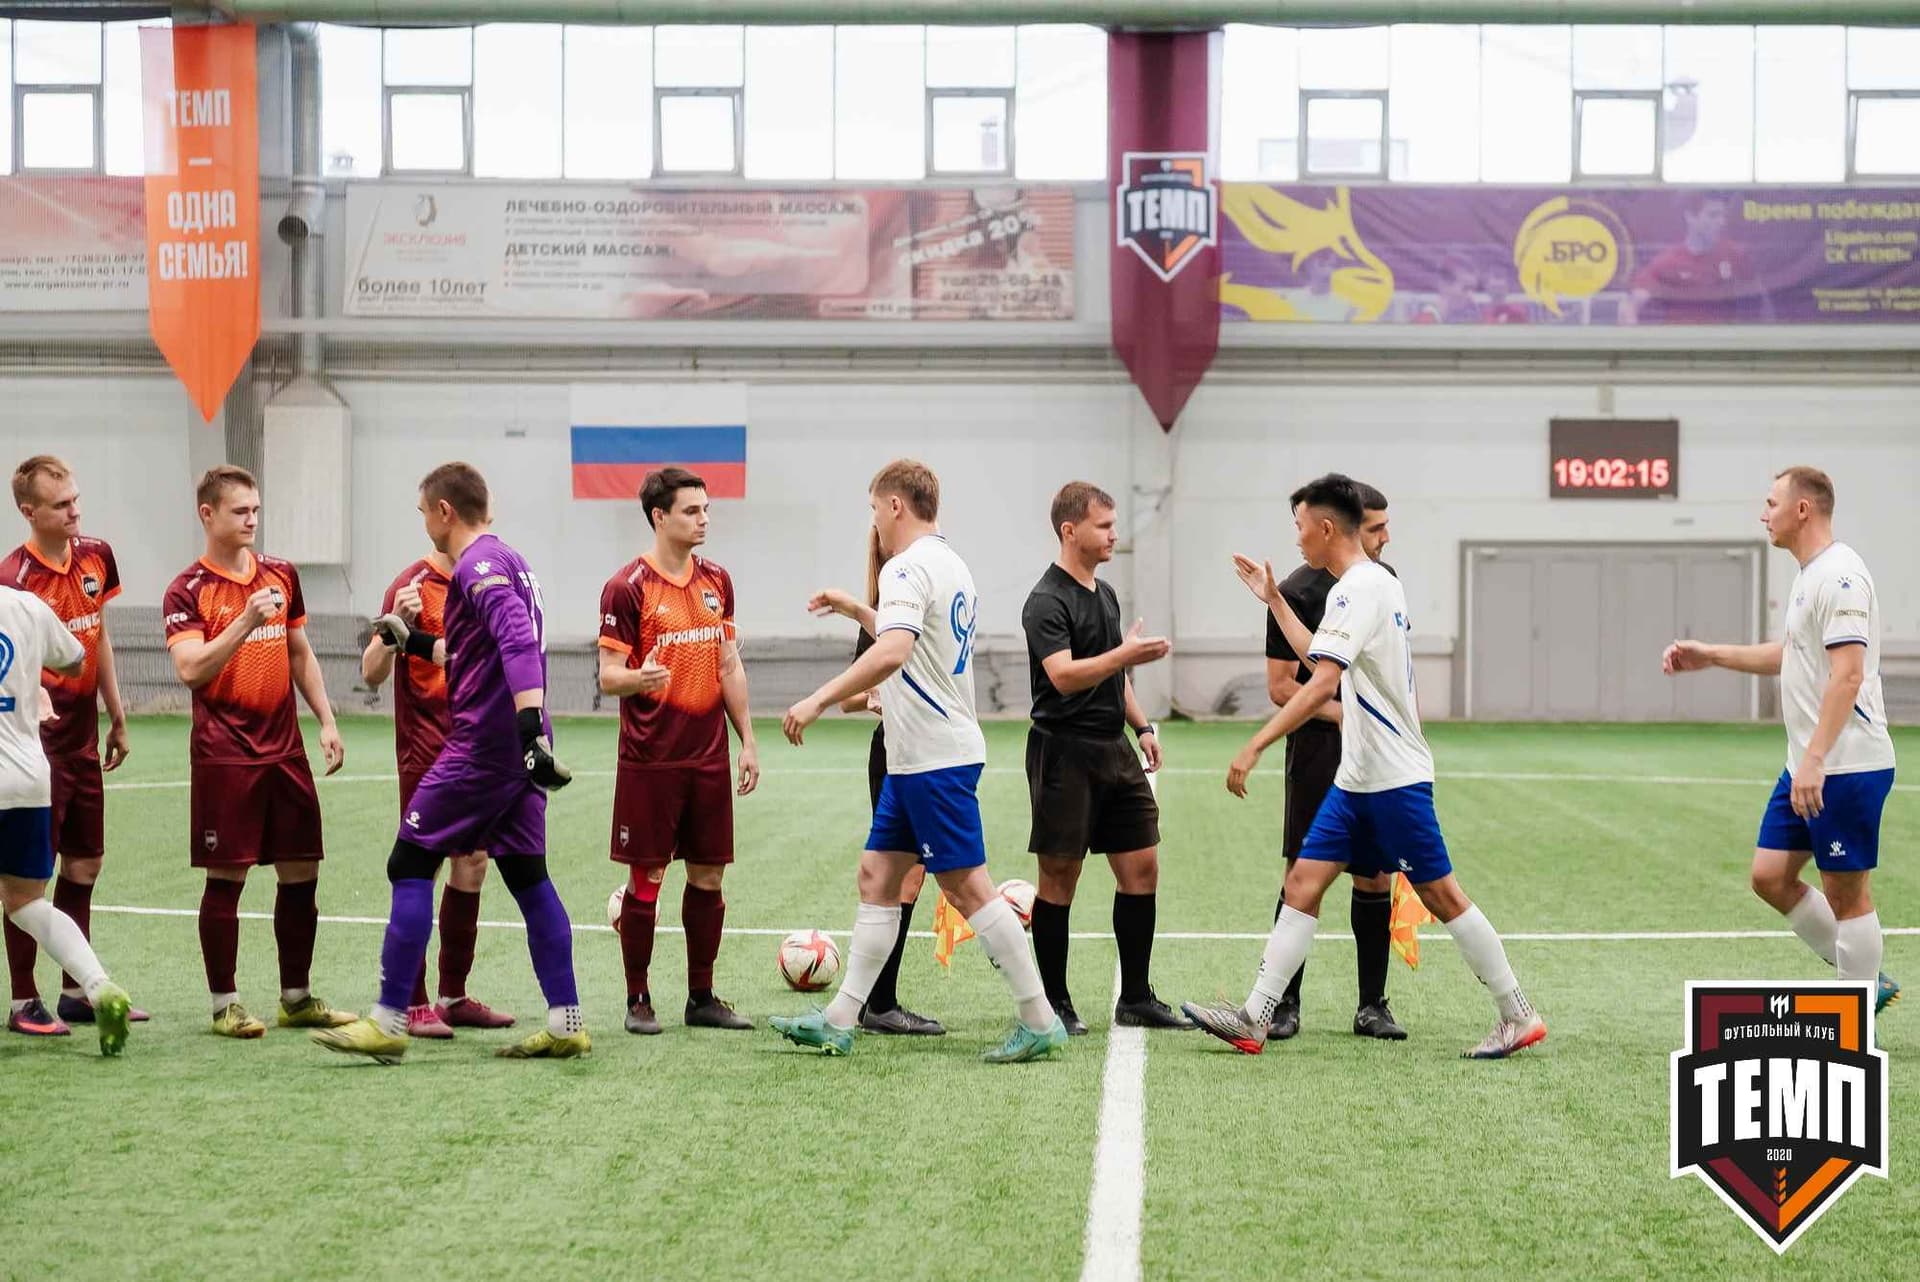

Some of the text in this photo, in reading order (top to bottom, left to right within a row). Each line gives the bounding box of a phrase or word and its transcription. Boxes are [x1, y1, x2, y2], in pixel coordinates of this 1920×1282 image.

[167, 89, 231, 128] ТЕМП
[167, 189, 236, 234] ОДНА
[505, 198, 773, 215] ЛЕЧЕБНО-ОЗДОРОВИТЕЛЬНЫЙ
[1127, 188, 1207, 232] ТЕМП
[1743, 199, 1813, 222] Время
[158, 240, 248, 280] СЕМЬЯ!
[505, 240, 587, 257] ДЕТСКИЙ
[1544, 240, 1608, 264] .БРО
[357, 276, 421, 295] более
[430, 279, 488, 296] 10лет
[1554, 457, 1670, 487] 19:02:15
